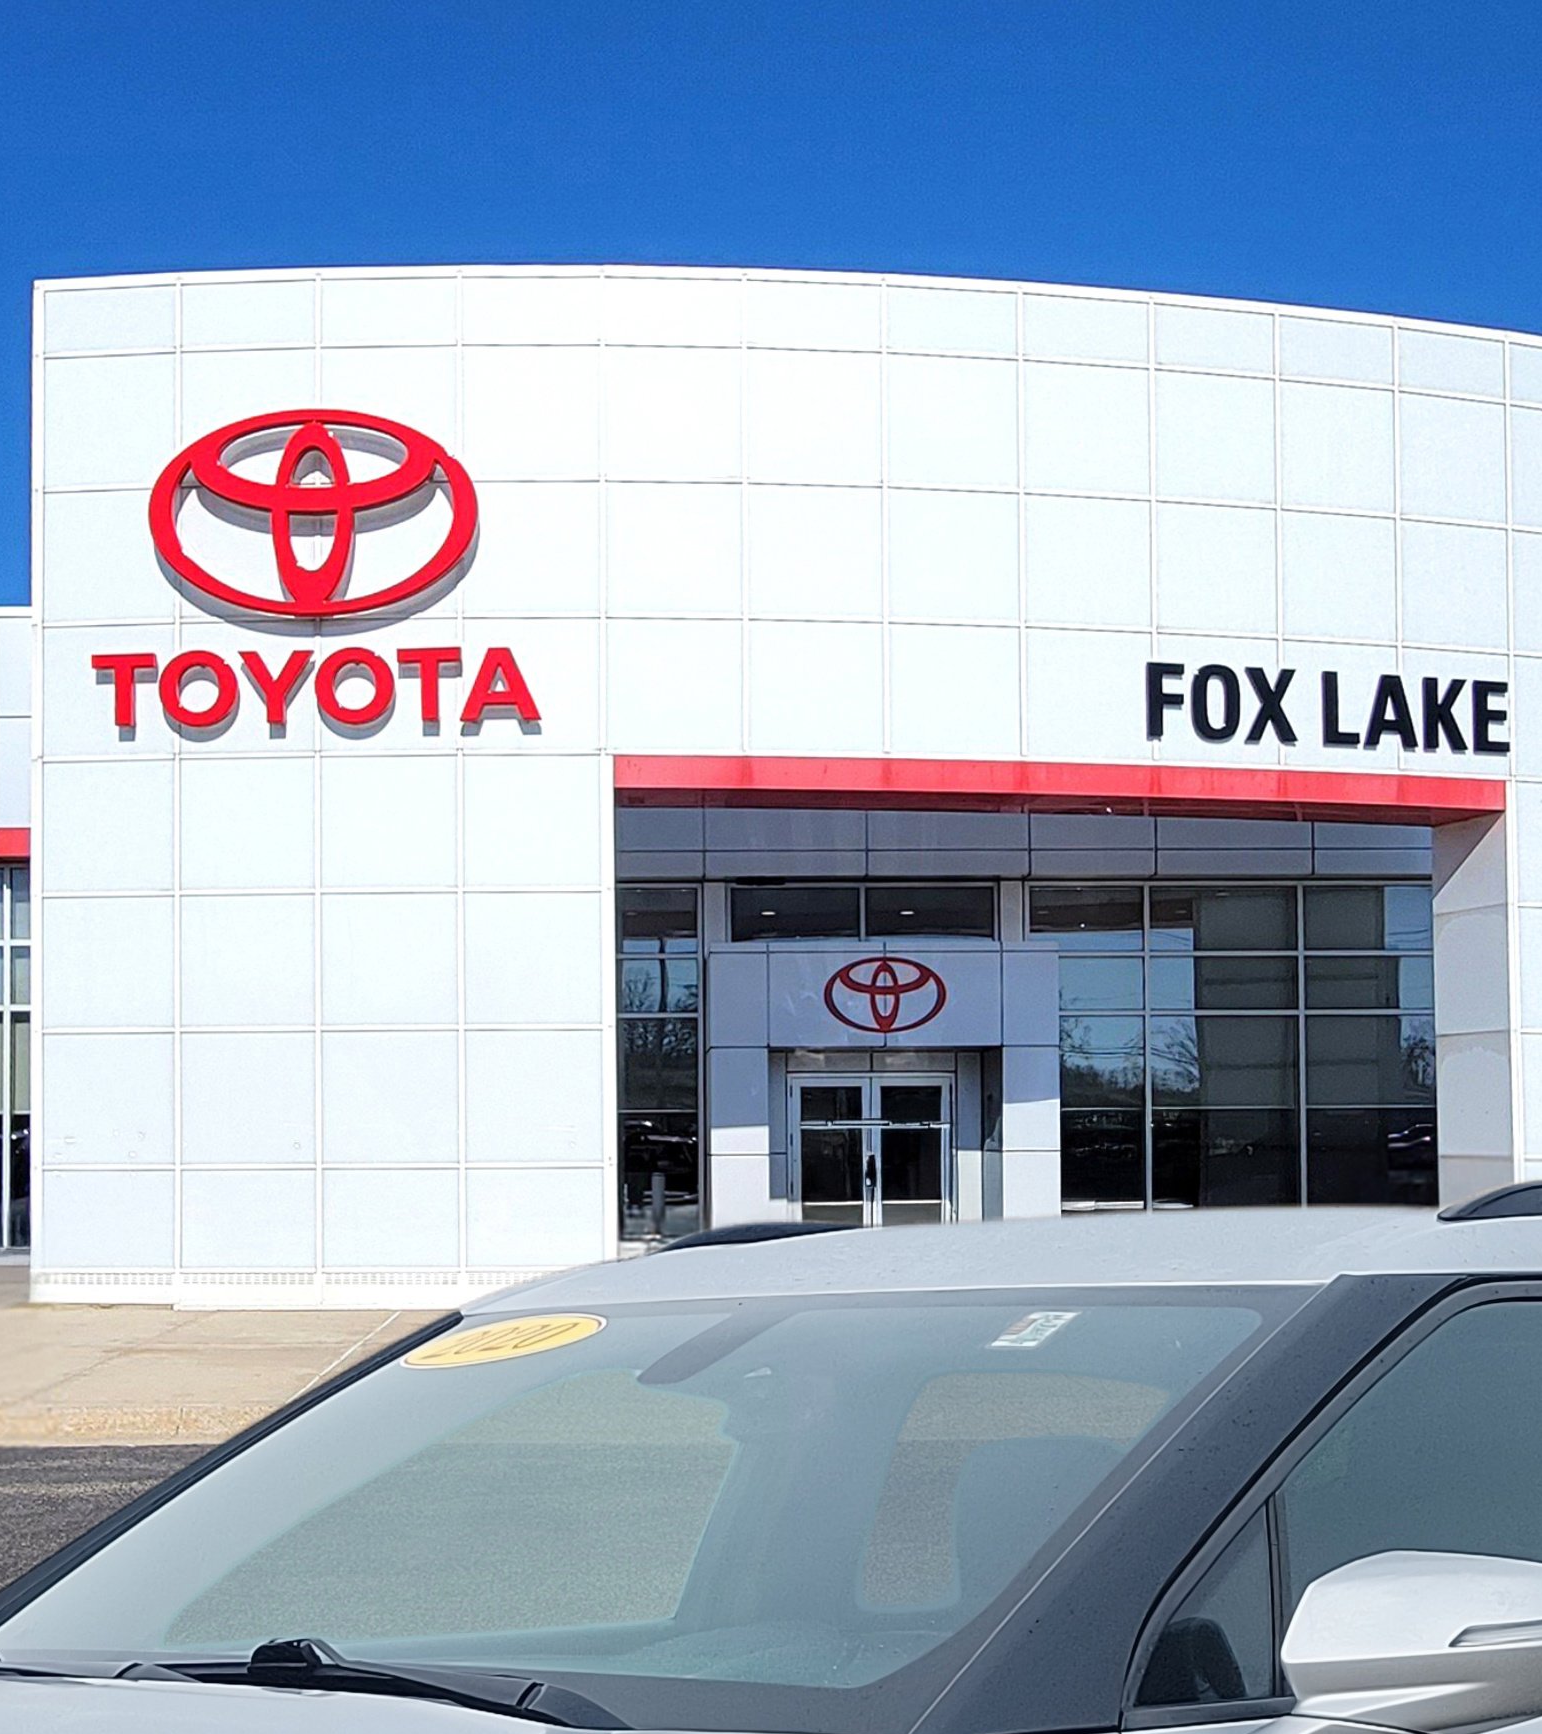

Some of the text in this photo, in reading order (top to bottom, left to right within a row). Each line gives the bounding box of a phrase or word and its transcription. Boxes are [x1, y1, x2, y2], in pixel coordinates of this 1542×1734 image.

[91, 646, 542, 741] TOYOTA
[1146, 661, 1510, 756] FOX LAKE
